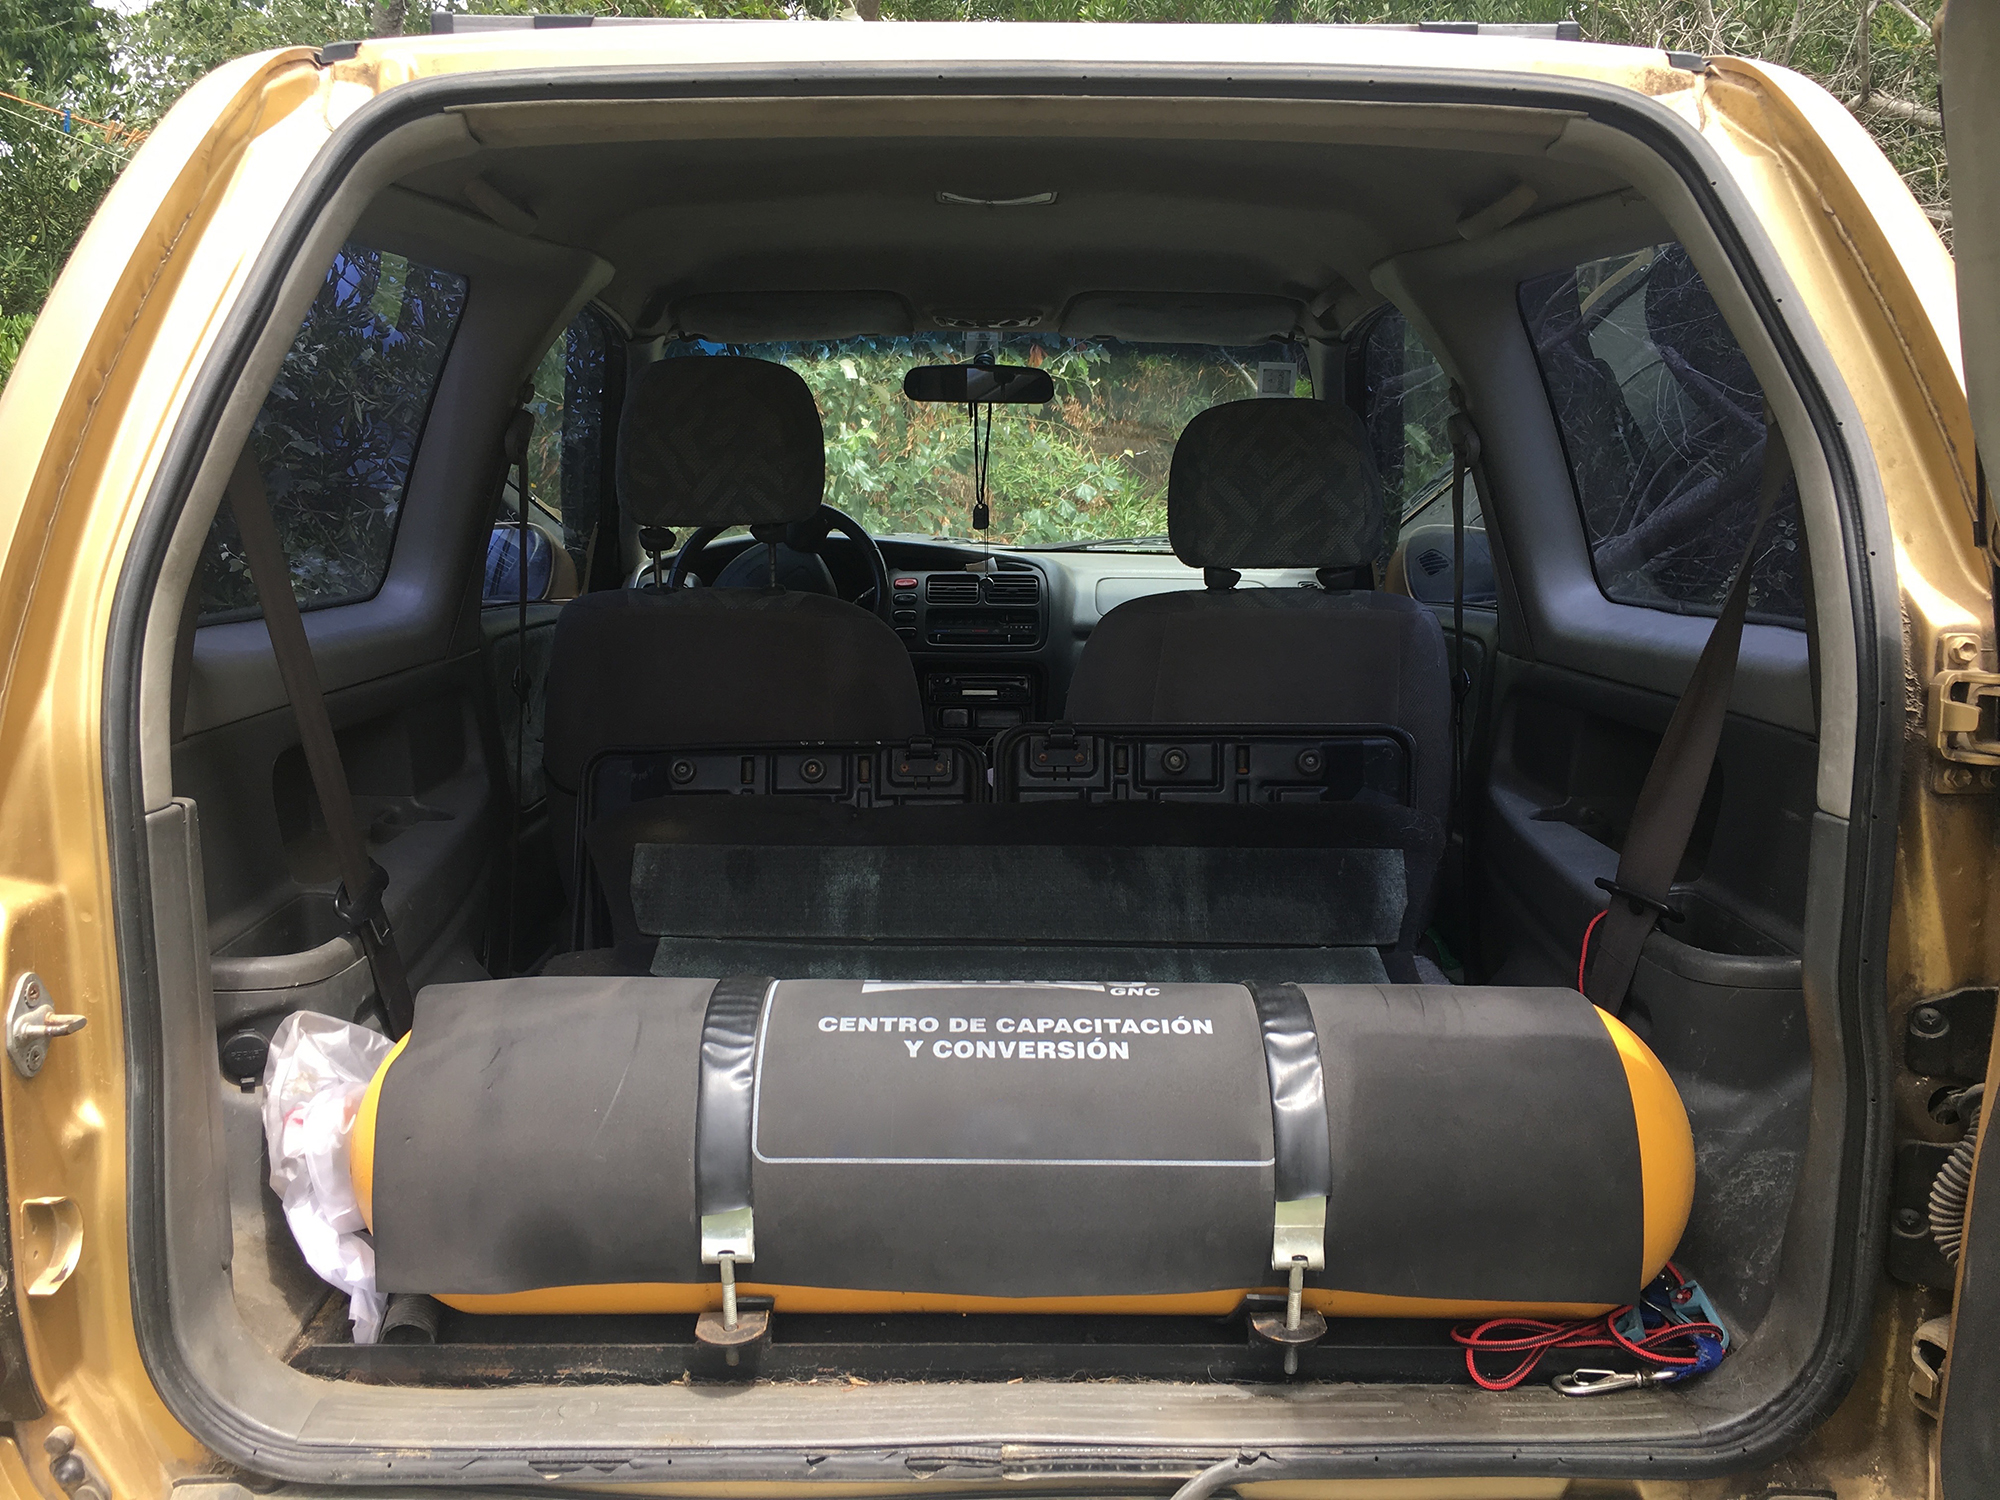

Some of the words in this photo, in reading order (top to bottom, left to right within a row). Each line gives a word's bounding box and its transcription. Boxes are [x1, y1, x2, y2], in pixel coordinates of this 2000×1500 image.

[1109, 987, 1161, 997] GNC
[817, 1016, 940, 1033] CENTRO
[948, 1017, 987, 1034] DE
[995, 1015, 1214, 1035] CAPACITACIÓN
[903, 1039, 925, 1059] Y
[932, 1036, 1130, 1060] CONVERSIÓN
